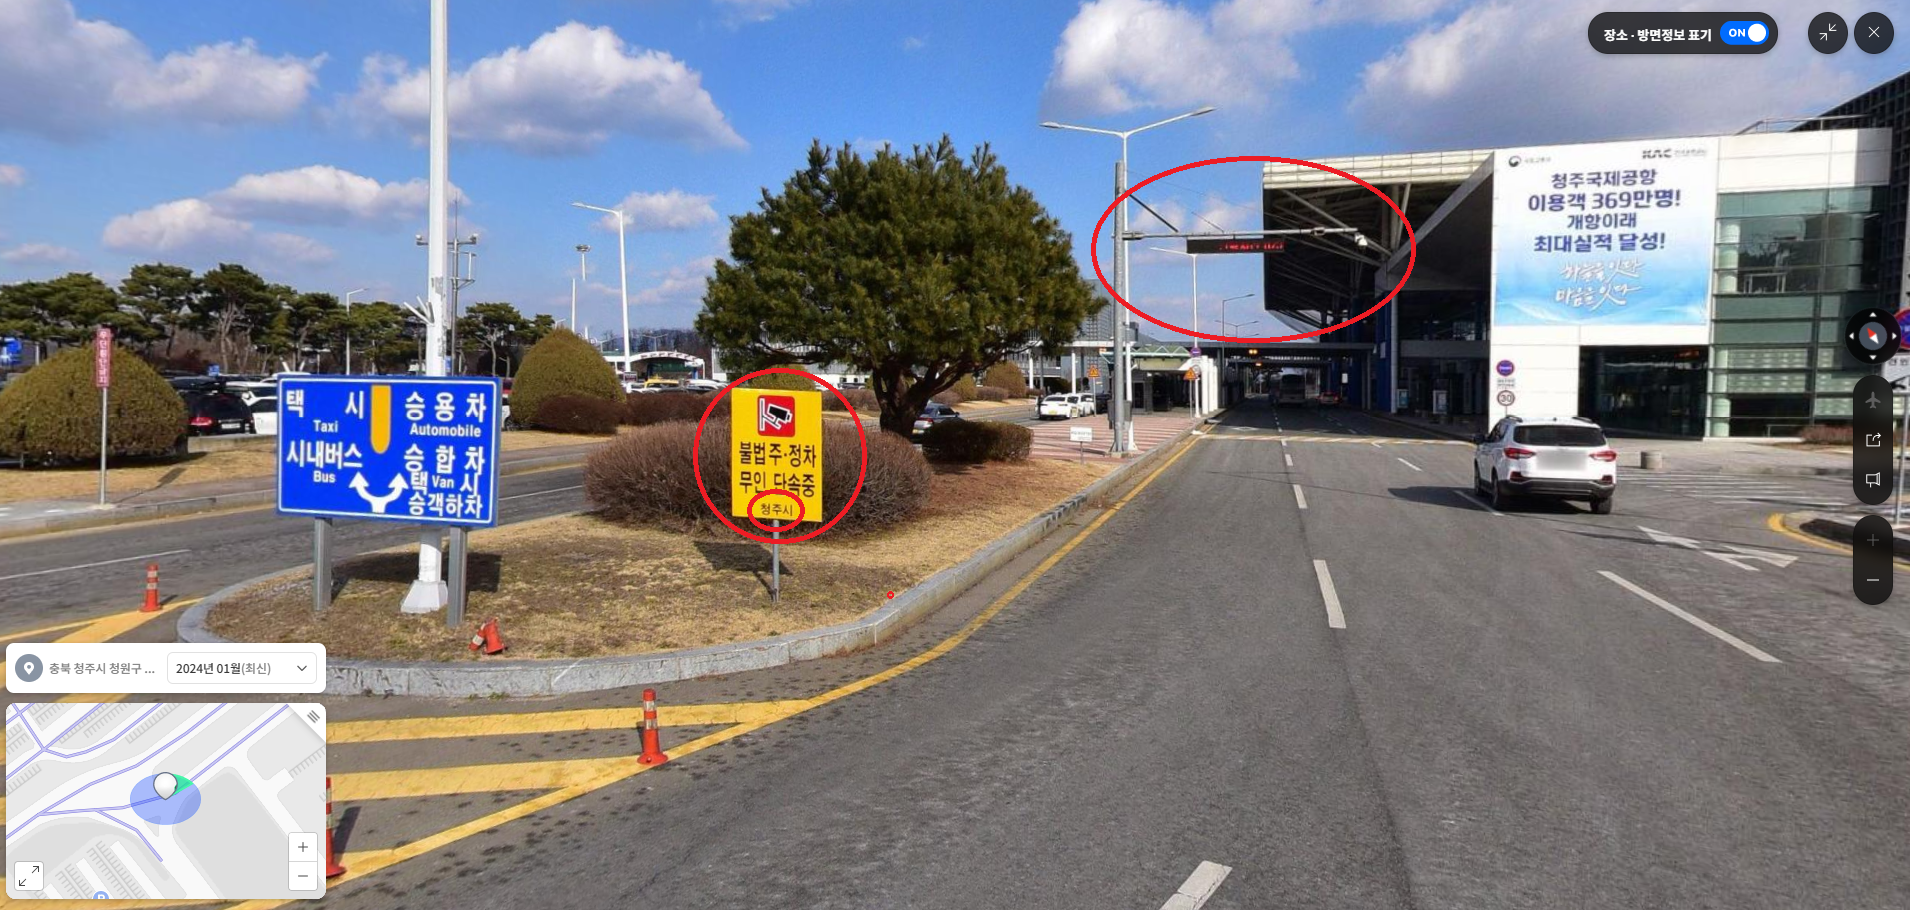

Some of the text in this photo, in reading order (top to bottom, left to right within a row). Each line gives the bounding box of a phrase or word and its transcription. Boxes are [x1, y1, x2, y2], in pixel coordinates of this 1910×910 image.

[1551, 168, 1658, 190] 청주국제공항
[1528, 189, 1681, 212] 이용객 369만명!
[1567, 213, 1637, 230] 개항이래
[1534, 232, 1665, 253] 최대실적 달성!
[313, 419, 338, 433] Taxi
[409, 423, 482, 437] Automobile
[286, 439, 363, 470] 시내버스
[739, 441, 766, 465] 불법
[313, 470, 336, 483] Bus
[431, 475, 455, 489] Van
[739, 470, 816, 498] 무인 단속중
[408, 491, 483, 519] 승객하차
[760, 502, 794, 517] 청주시
